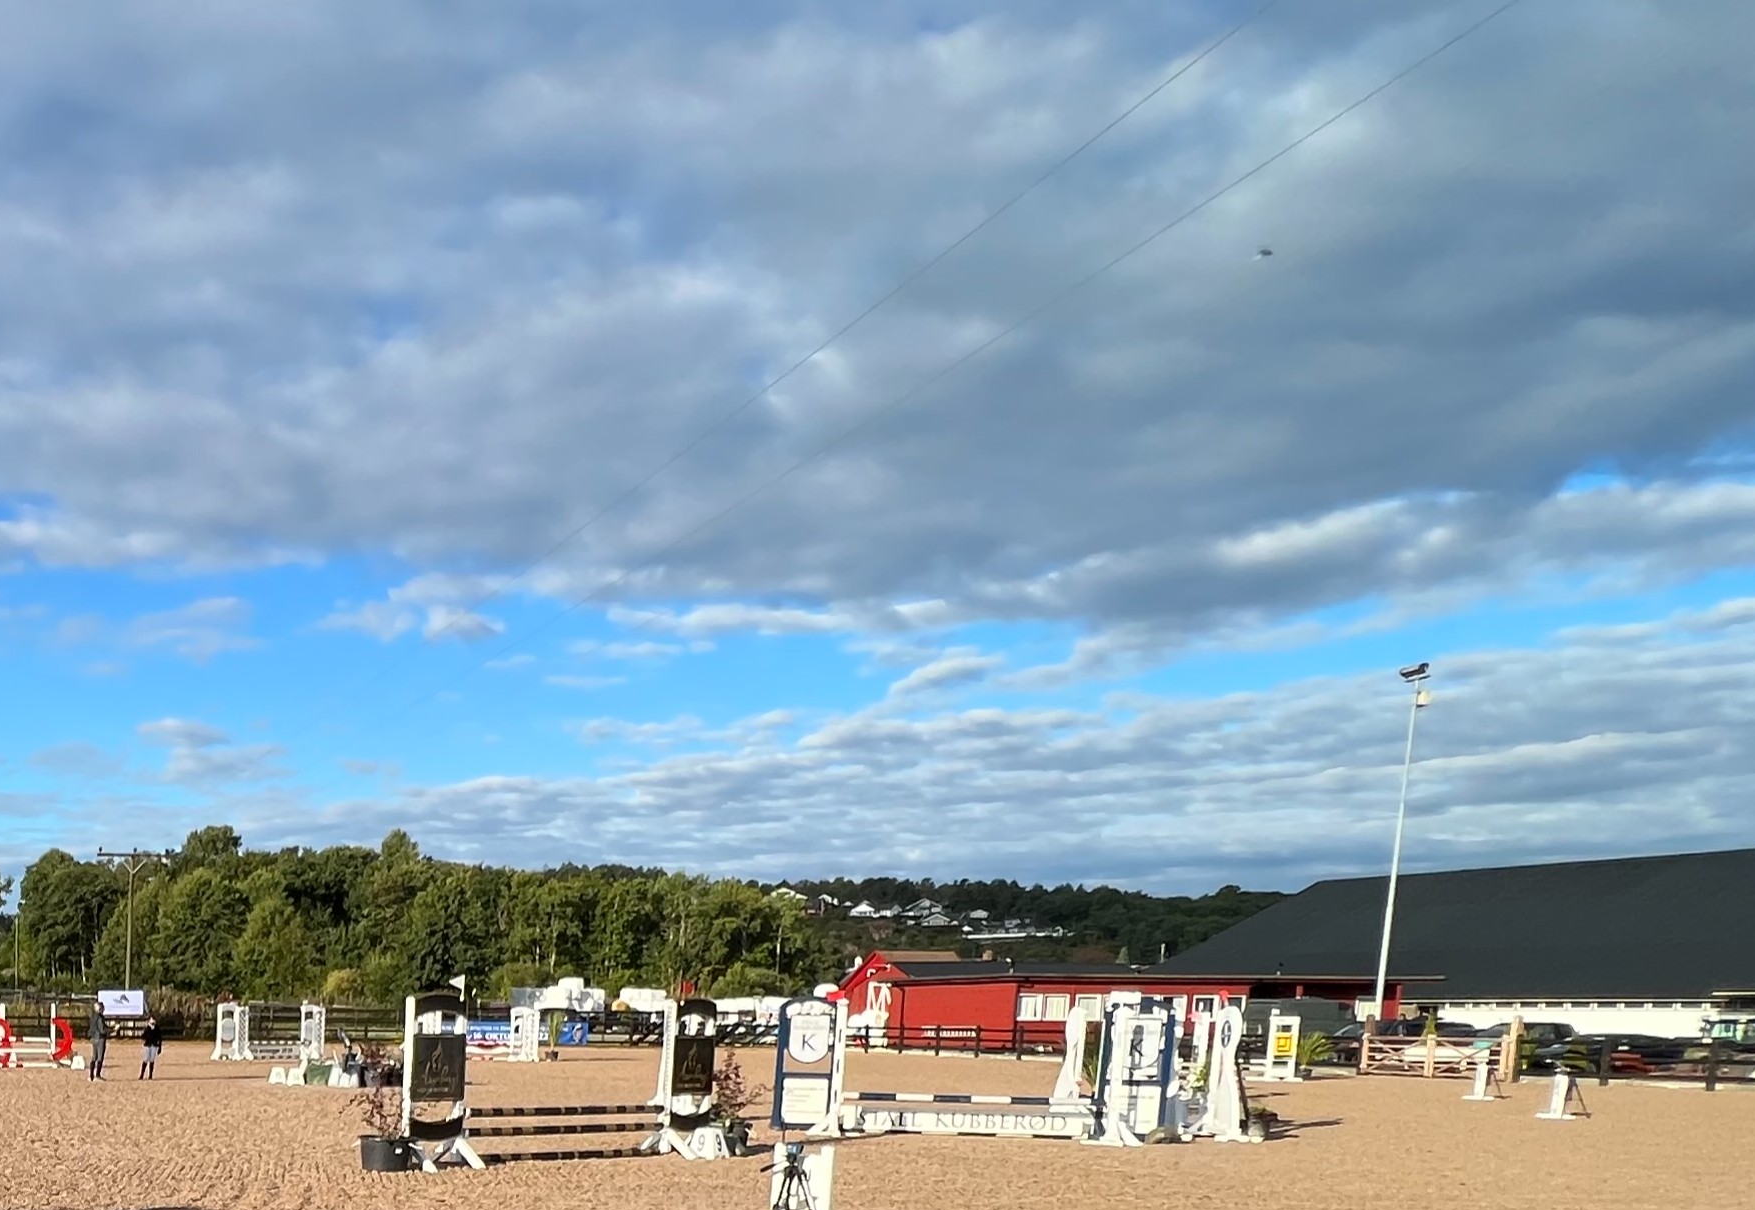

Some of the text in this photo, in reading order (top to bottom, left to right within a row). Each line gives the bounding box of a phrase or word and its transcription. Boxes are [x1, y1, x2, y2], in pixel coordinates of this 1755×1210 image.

[802, 1033, 817, 1052] K
[1129, 1039, 1144, 1057] K
[935, 1112, 1067, 1131] KUBBERØD
[697, 1134, 705, 1152] 9
[715, 1133, 722, 1152] 9
